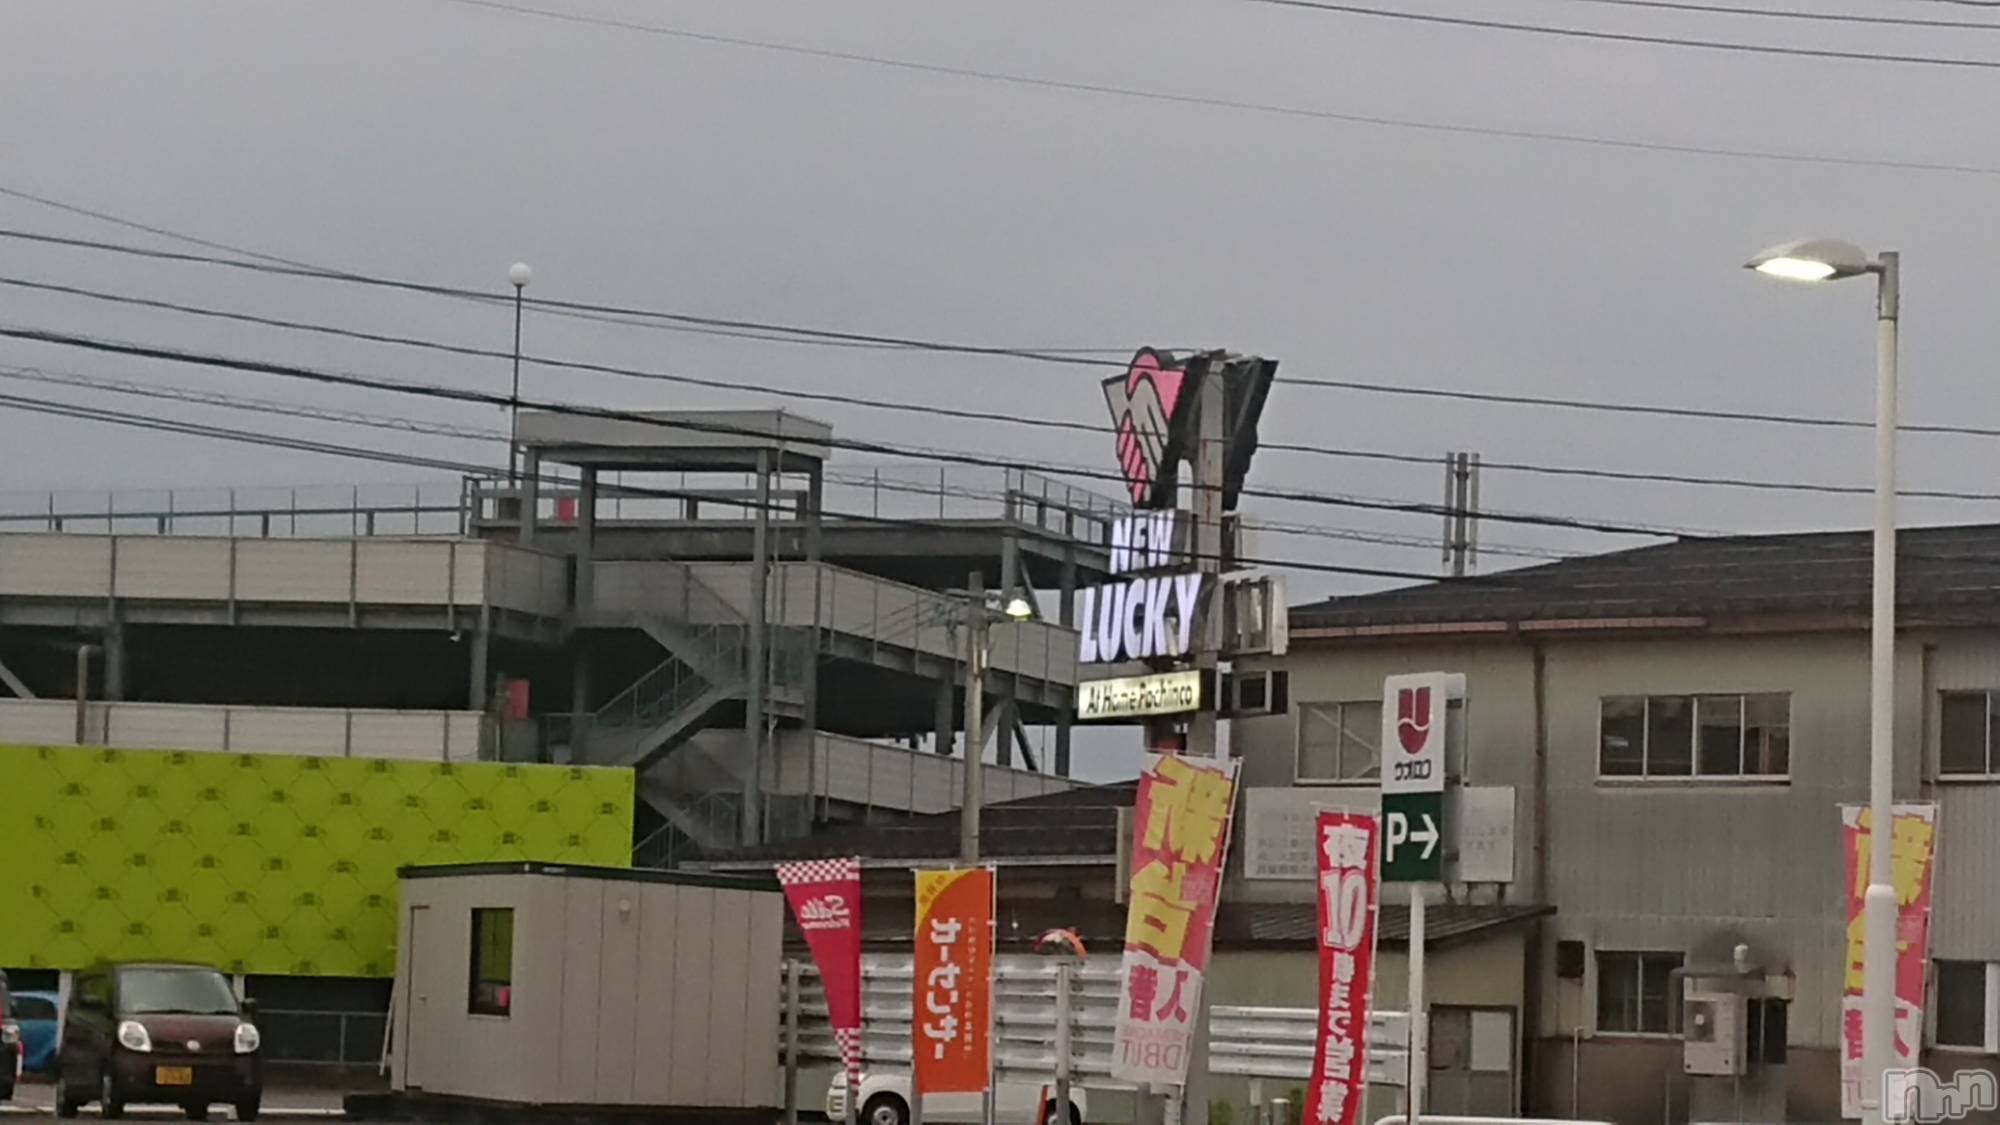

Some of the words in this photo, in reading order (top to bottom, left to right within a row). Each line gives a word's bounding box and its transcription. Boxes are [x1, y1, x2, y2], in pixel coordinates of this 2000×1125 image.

[1110, 509, 1176, 575] NEW
[1079, 573, 1203, 663] LUCKY
[1101, 684, 1136, 714] Home
[1394, 759, 1432, 781] ウオロク
[1386, 811, 1408, 863] P
[923, 917, 962, 1060] カーセンサー
